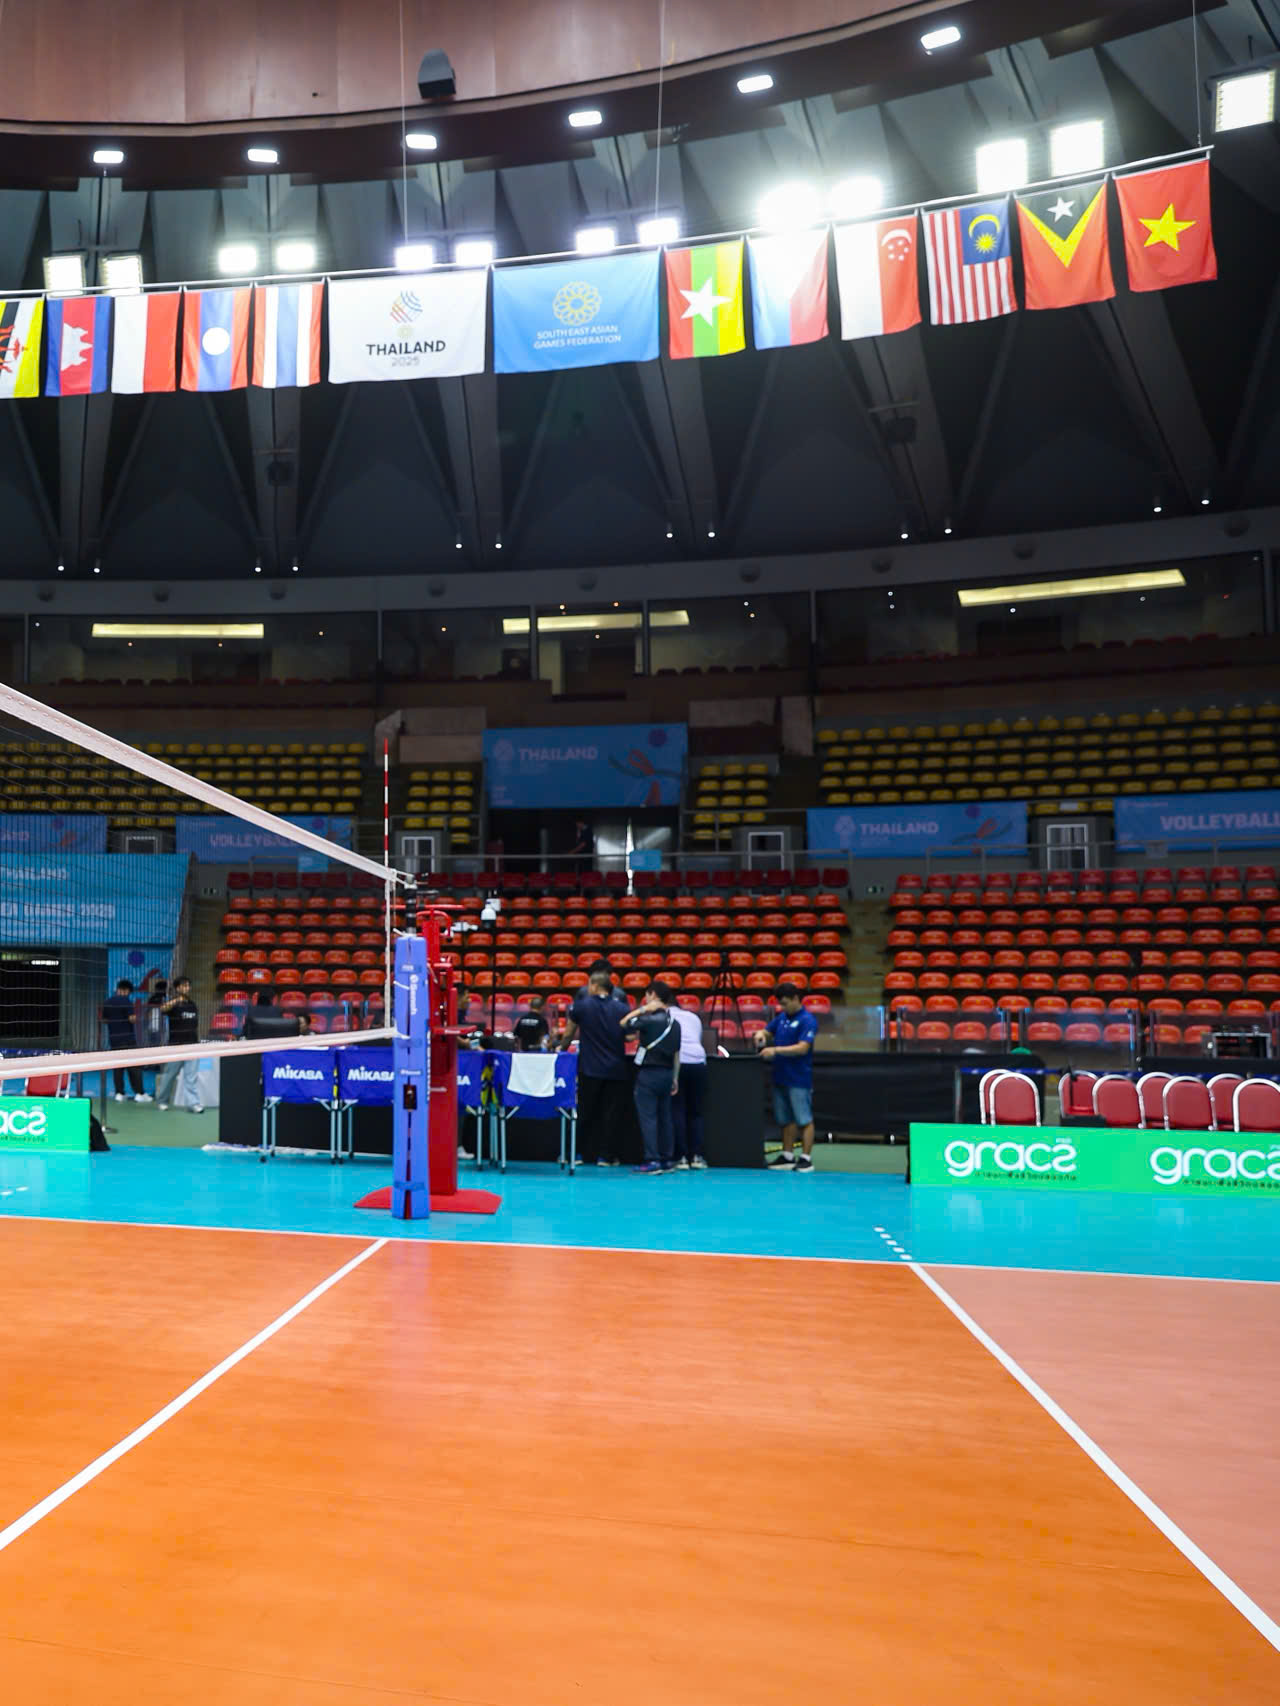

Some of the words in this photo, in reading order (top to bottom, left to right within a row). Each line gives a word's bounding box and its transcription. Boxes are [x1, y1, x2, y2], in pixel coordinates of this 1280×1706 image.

[537, 329, 567, 339] SOUTH
[568, 327, 589, 336] EAST
[591, 325, 618, 335] ASIAN
[366, 340, 447, 356] THAILAND
[534, 338, 565, 349] GAMES
[567, 335, 621, 346] FEDERATION
[518, 746, 599, 761] THAILAND
[859, 821, 939, 836] THAILAND
[1159, 811, 1280, 831] VOLLEYBALL
